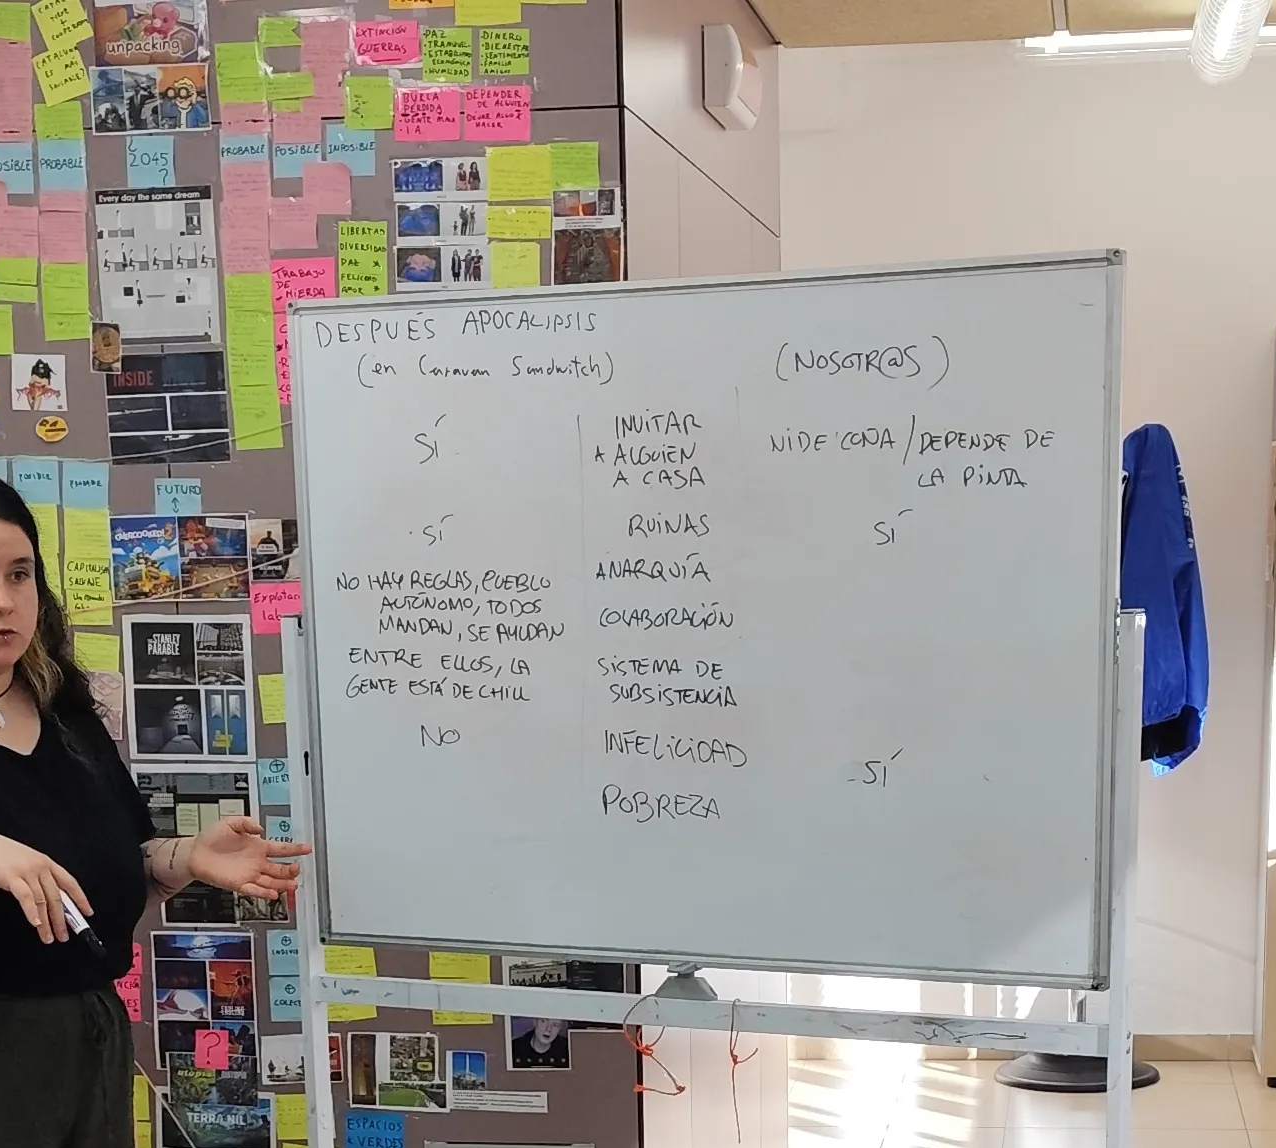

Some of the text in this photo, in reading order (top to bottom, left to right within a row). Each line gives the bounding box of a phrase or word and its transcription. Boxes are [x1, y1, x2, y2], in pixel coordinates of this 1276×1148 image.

[106, 38, 182, 55] unpacking
[466, 90, 522, 101] DEPENDER
[129, 152, 169, 167] 2045
[221, 143, 265, 157] PROBABLE
[275, 143, 321, 156] POSIBLE
[39, 158, 84, 171] PROBABLE
[98, 195, 119, 203] Every
[121, 194, 136, 202] day
[174, 191, 200, 199] dream
[340, 226, 385, 236] LIBERTAD
[275, 280, 290, 289] DE
[315, 310, 597, 348] DESPUÉS APOCALIPSIS
[615, 409, 702, 439] INVITAR
[414, 414, 446, 463] SÍ
[1024, 429, 1055, 449] DE
[614, 442, 696, 466] ALGUIEN
[613, 466, 705, 489] A CASA
[963, 464, 1027, 487] PINTA
[157, 484, 201, 496] FUTURO
[423, 514, 453, 546] SÍ
[628, 512, 709, 538] RUINAS
[874, 509, 913, 545] SÍ
[596, 553, 711, 582] ANARQUÍA
[337, 569, 551, 594] NO HAY REGLAS, PUEBLO
[487, 599, 542, 617] TODOS
[599, 602, 734, 630] COLABORACIÓN
[153, 634, 181, 644] STANLEY
[379, 615, 565, 644] MANDAN, SE AYUDAN
[147, 643, 181, 655] PARABLE
[349, 648, 422, 668] ENTRE
[511, 658, 530, 676] LA
[598, 655, 723, 680] SISTEMA DE
[346, 674, 531, 701] GENTE ESTÁ DE CHILL
[610, 683, 737, 707] SUBSISTENCIA
[420, 724, 461, 747] NO
[605, 729, 748, 768] INFELICIDAD
[863, 748, 904, 788] SÍ
[602, 784, 720, 823] POBREZA
[186, 1112, 247, 1126] TERRA NIL
[346, 1117, 402, 1131] ESPACIOS
[357, 1136, 404, 1148] VERDES
